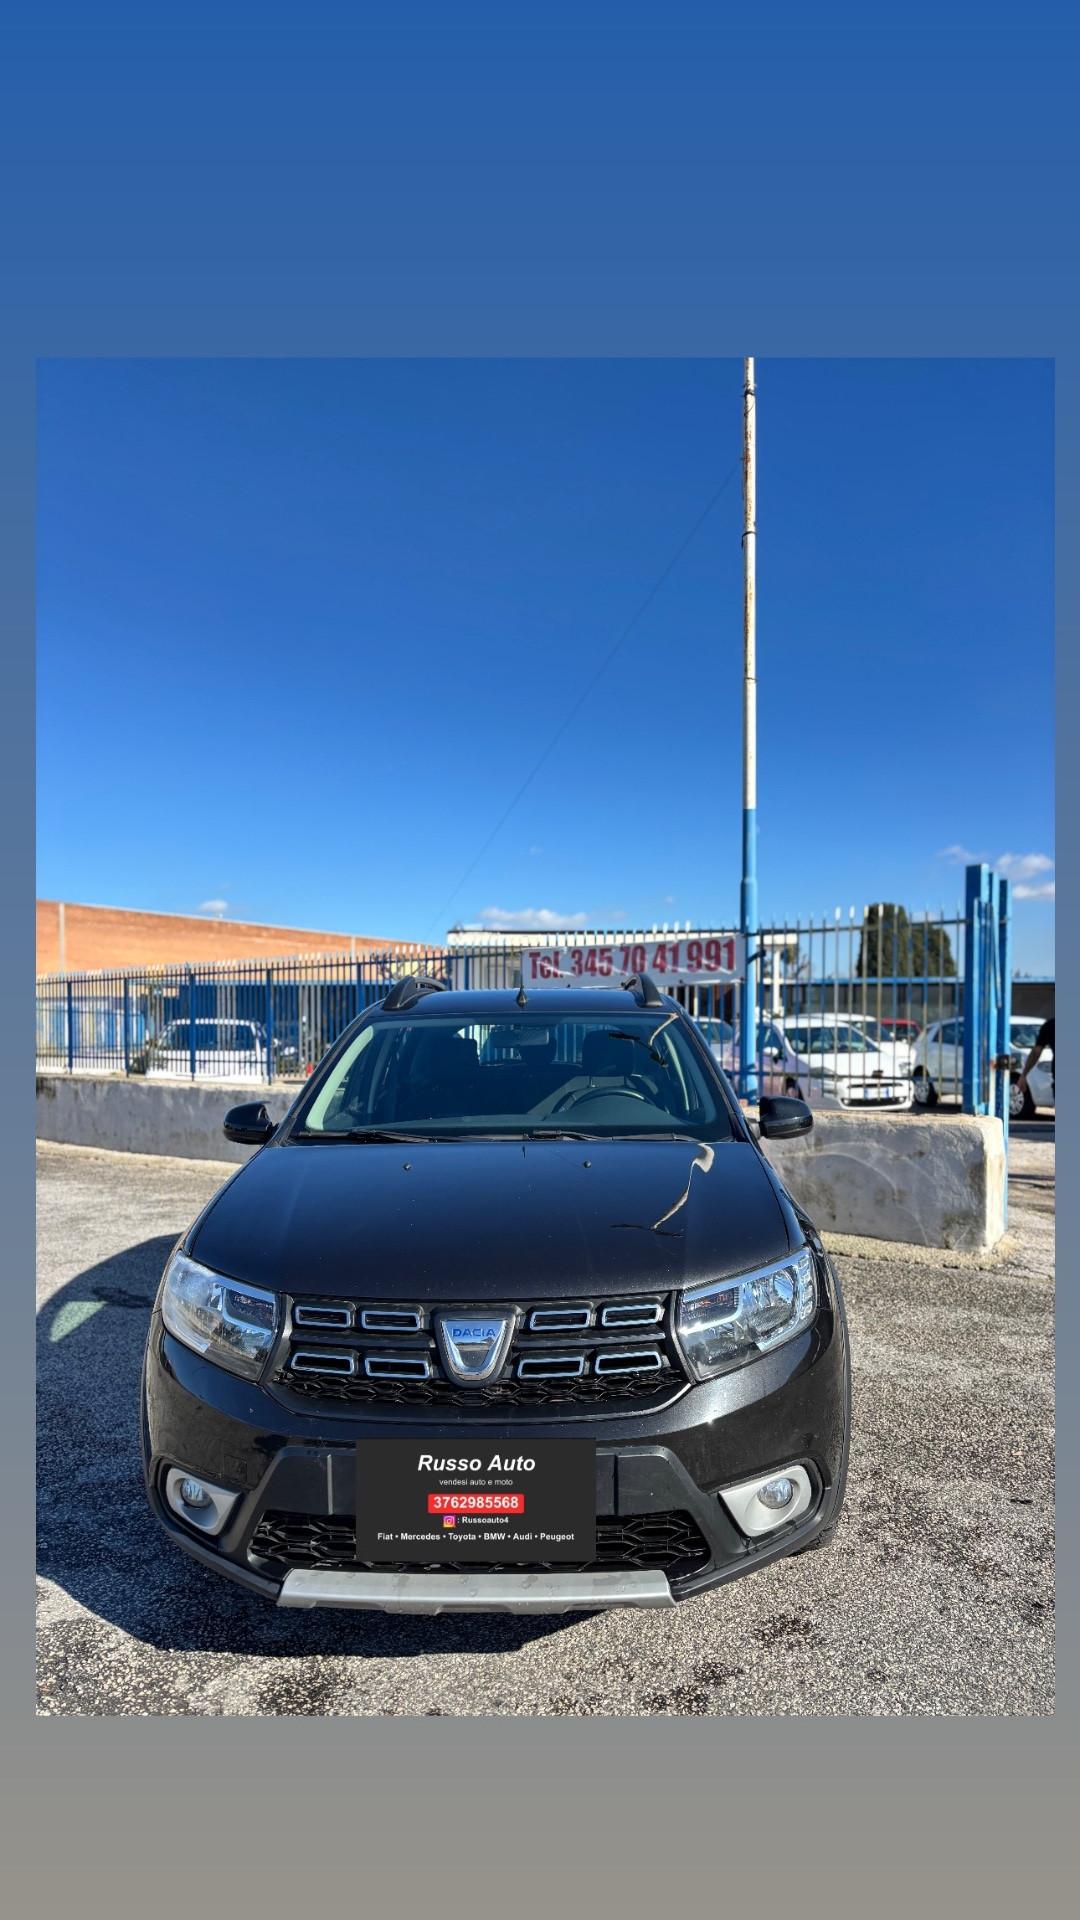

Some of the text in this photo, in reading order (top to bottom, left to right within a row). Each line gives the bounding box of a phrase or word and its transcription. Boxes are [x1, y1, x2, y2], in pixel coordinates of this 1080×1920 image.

[529, 938, 735, 979] Tel. 345 70 41 991
[452, 1328, 496, 1337] DACIA
